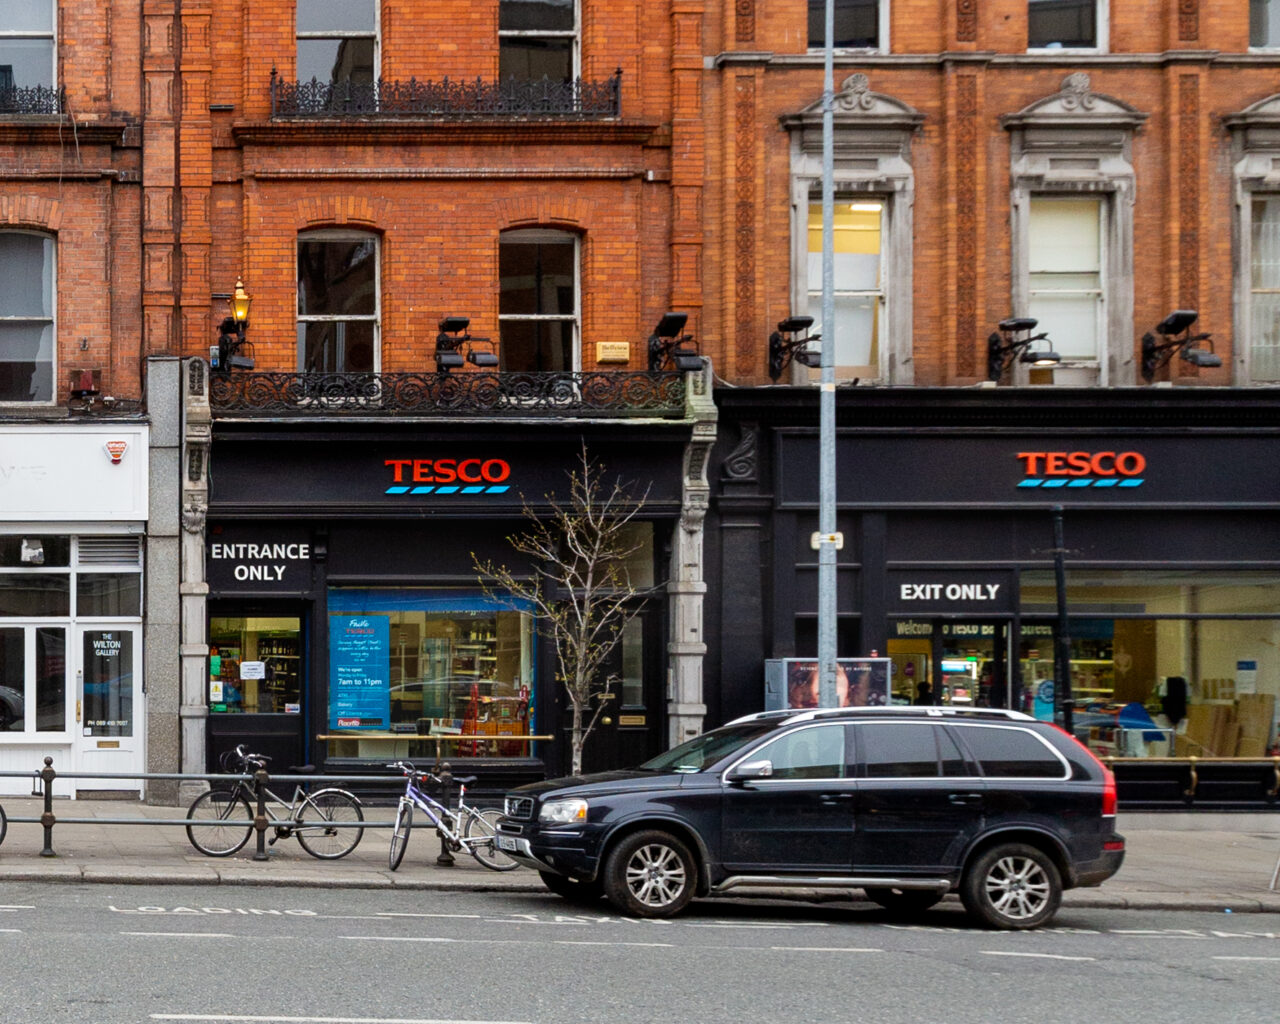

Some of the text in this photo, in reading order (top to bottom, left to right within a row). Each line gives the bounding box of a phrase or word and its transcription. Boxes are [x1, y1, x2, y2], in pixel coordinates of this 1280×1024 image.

[384, 459, 511, 483] TESCO
[1017, 451, 1147, 476] TESCO
[211, 543, 310, 559] ENTRANCE
[234, 565, 286, 581] ONLY
[900, 584, 1000, 600] EXIT ONLY
[896, 619, 933, 635] Welcom
[93, 640, 121, 649] WILTON
[364, 678, 382, 687] 11pm
[108, 905, 318, 916] LOADING
